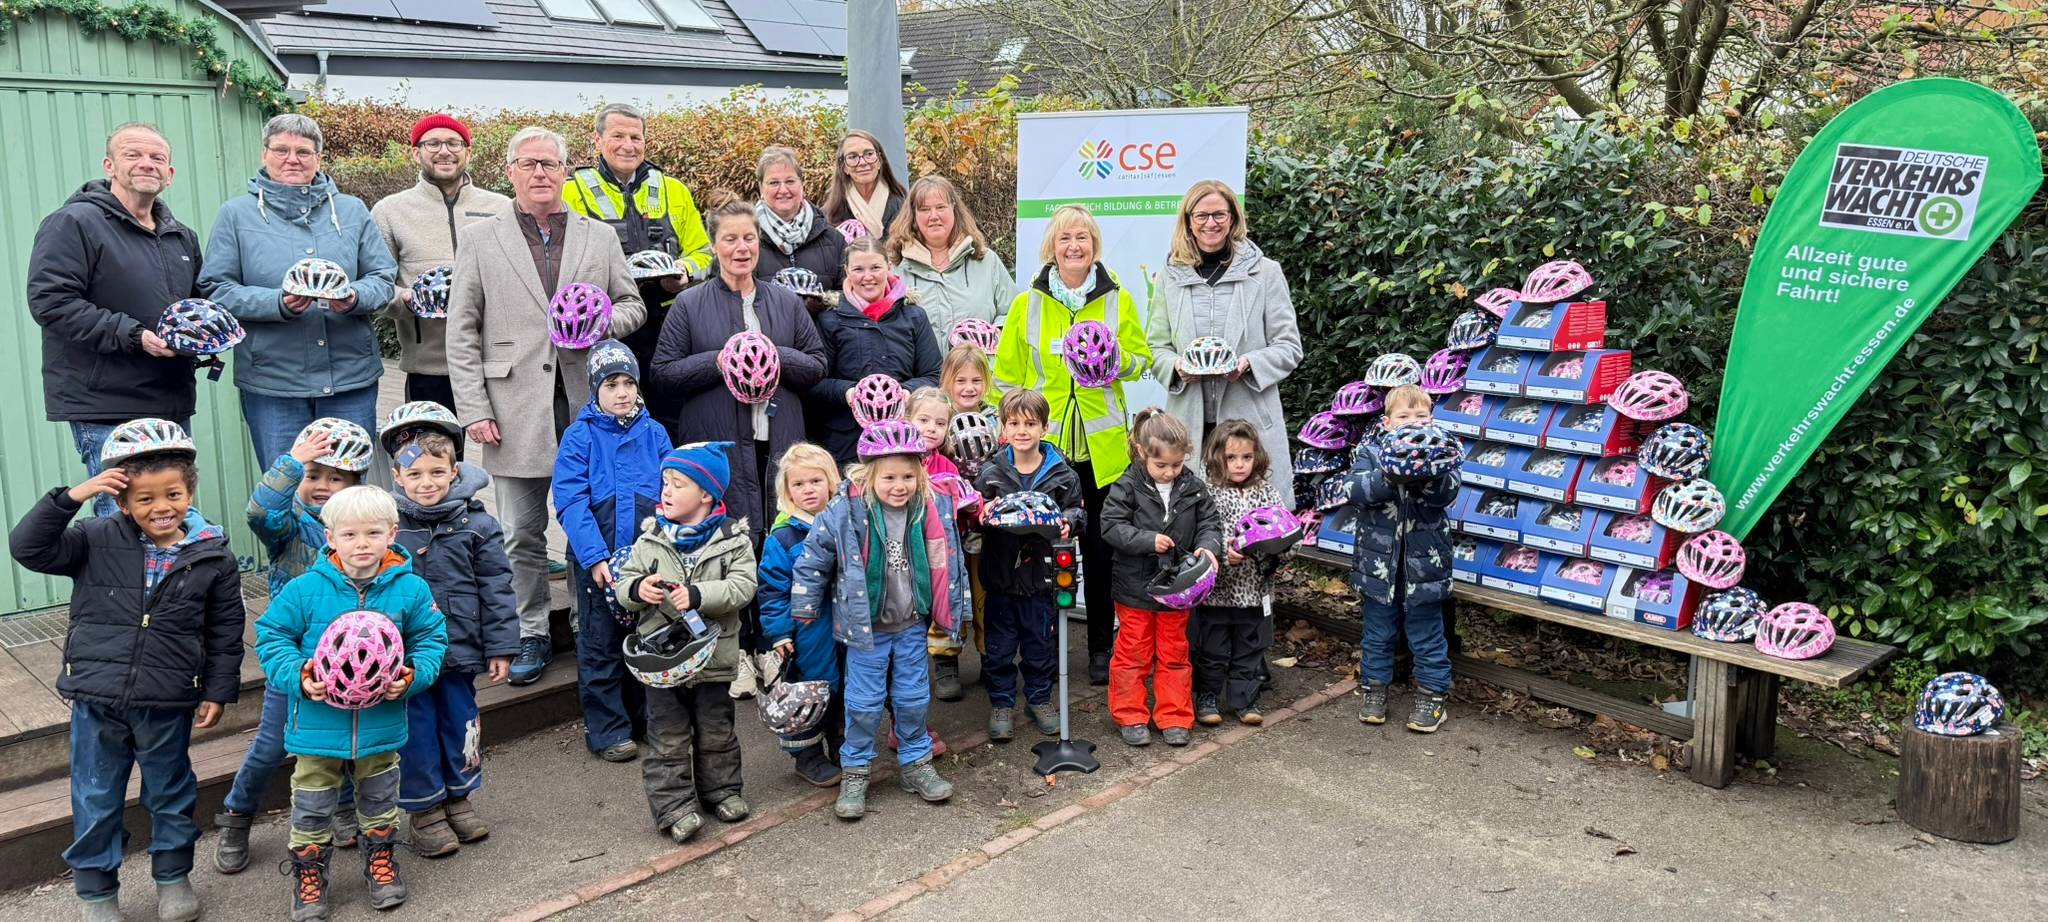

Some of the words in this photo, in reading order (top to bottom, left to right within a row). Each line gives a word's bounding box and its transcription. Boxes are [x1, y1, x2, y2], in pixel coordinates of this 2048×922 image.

[1119, 142, 1177, 171] cse
[1903, 151, 1986, 170] DEUTSCHE
[1831, 158, 1980, 196] VERKEHRS
[1045, 200, 1101, 213] FACICH
[1103, 202, 1142, 212] BILDUNG
[1144, 202, 1152, 210] &
[1825, 184, 1928, 218] WACHT
[1867, 217, 1894, 228] ESSEN
[1785, 245, 1853, 266] Allzeit
[1857, 255, 1907, 272] gute
[1781, 266, 1823, 282] und
[1828, 270, 1909, 291] sichere
[1776, 282, 1840, 303] Fahrt!
[1735, 297, 1916, 511] www.verkehrswacht-essen.de
